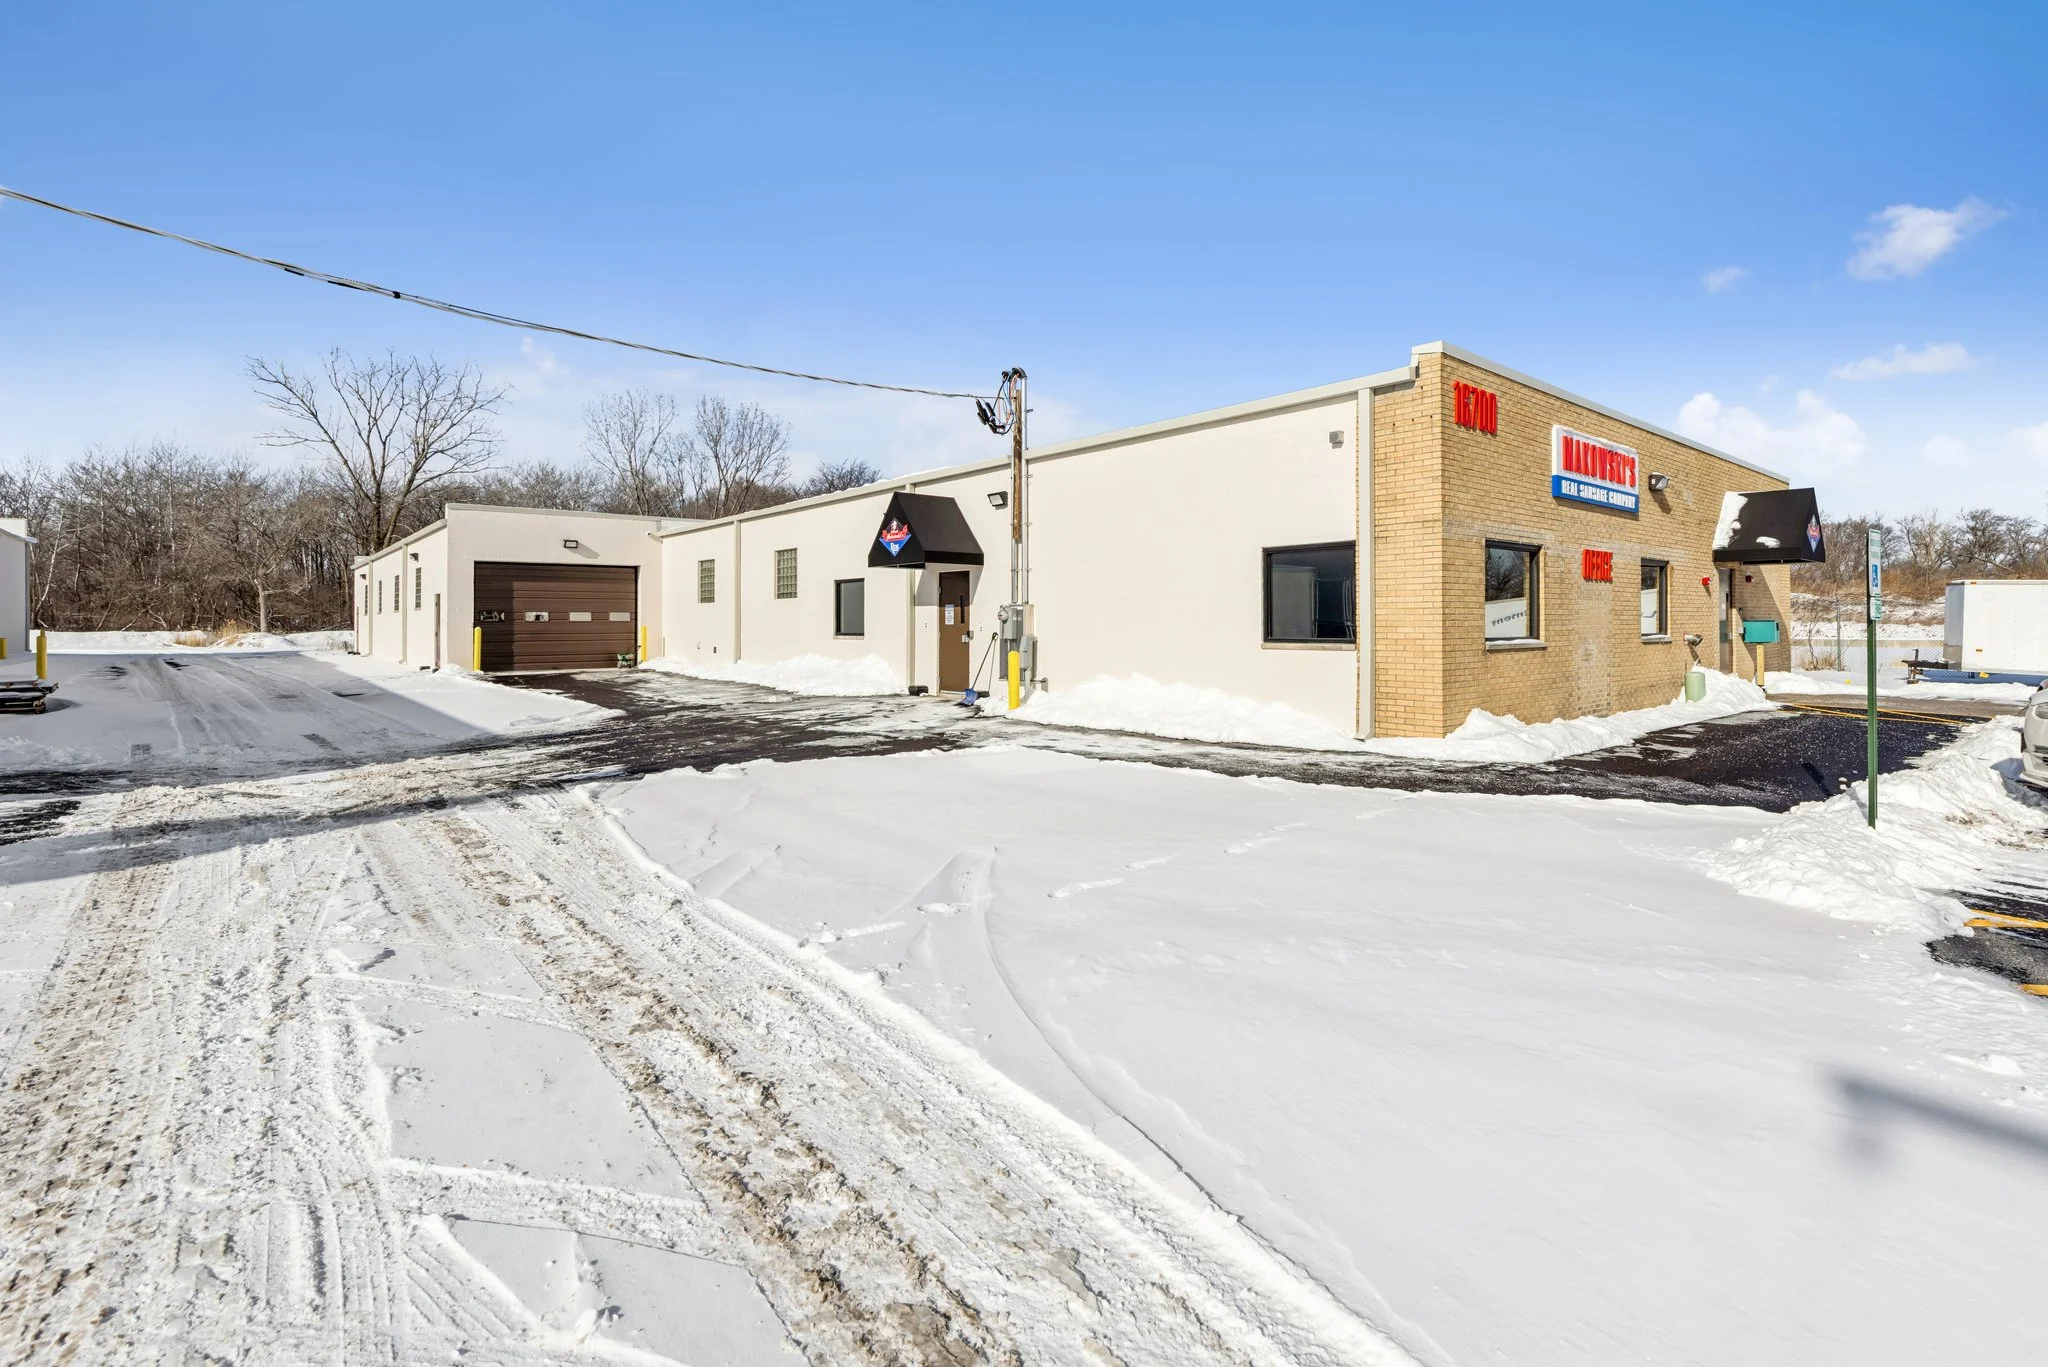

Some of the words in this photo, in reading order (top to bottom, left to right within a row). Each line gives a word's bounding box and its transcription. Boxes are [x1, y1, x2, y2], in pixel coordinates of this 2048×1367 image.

[1453, 380, 1497, 435] 16700
[1562, 435, 1636, 488] MAKOWSKI'S
[1562, 480, 1578, 496] REAL
[1580, 484, 1608, 503] SAUSAGE
[1609, 491, 1635, 508] COMPANY
[1582, 548, 1613, 582] OFFICE
